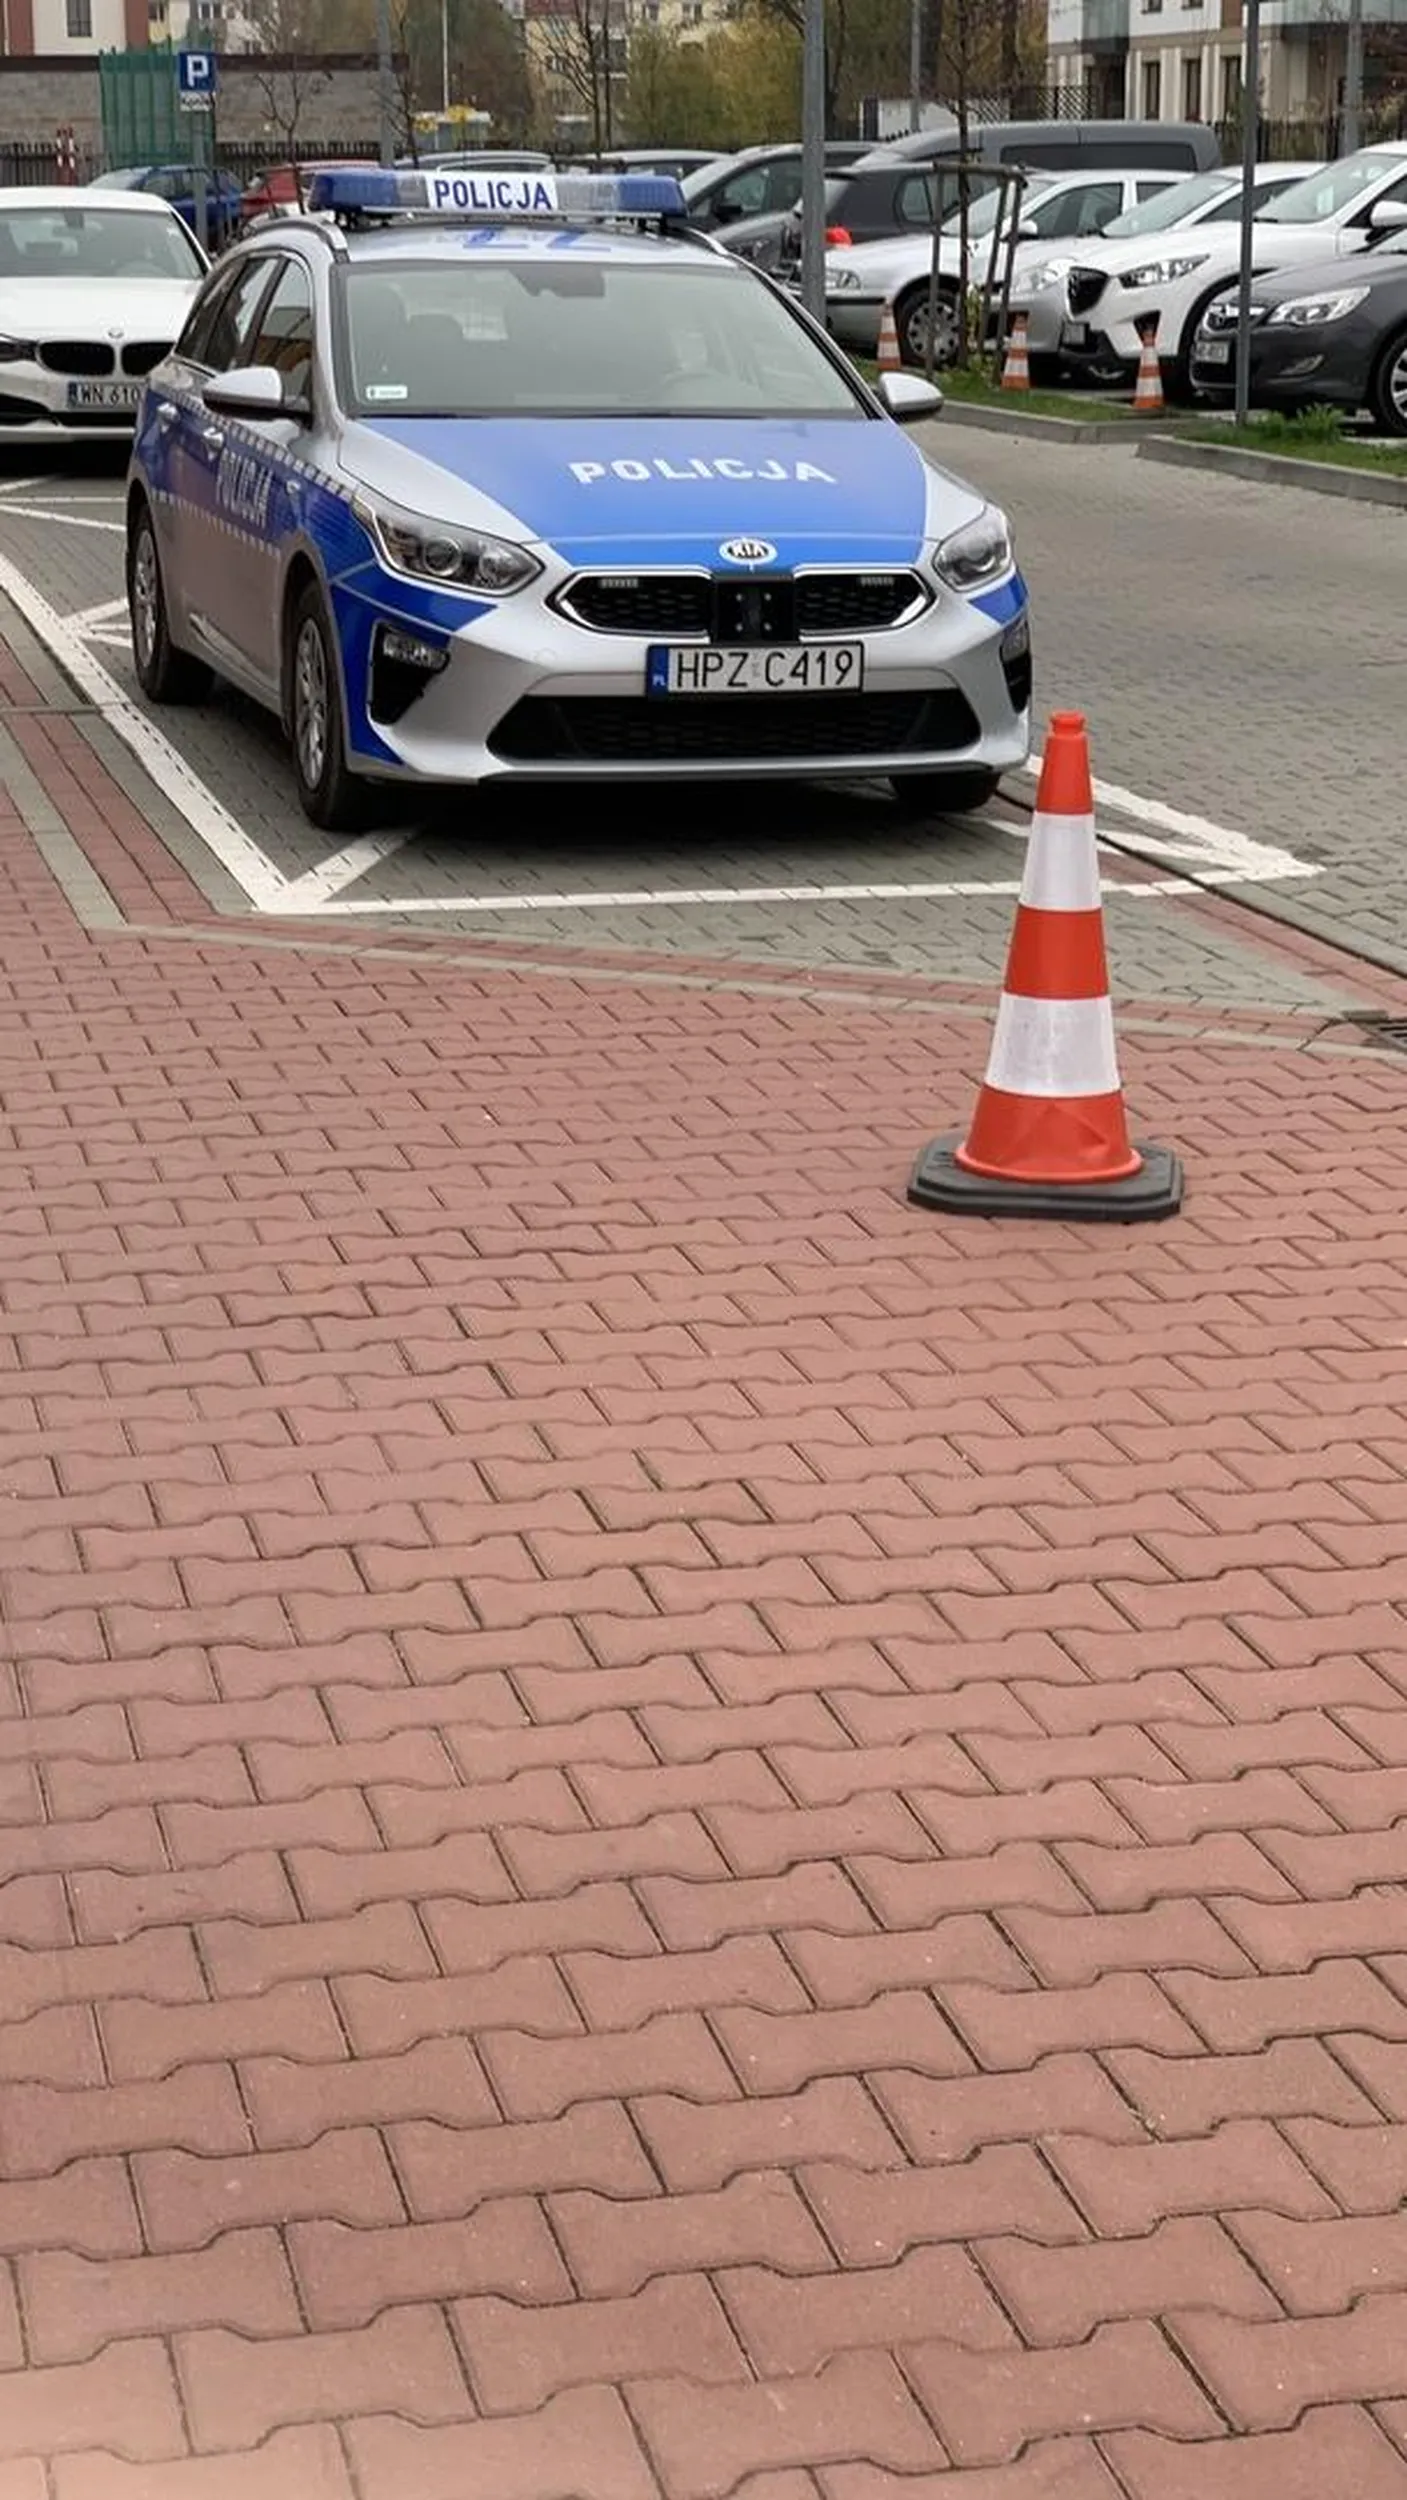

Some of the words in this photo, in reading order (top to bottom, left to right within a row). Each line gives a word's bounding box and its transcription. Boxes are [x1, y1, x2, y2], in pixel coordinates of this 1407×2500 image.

[187, 55, 209, 87] P
[434, 179, 553, 210] POLICJA
[80, 383, 104, 404] WN
[568, 458, 838, 485] POLICJA
[216, 447, 275, 529] POLICJA
[676, 651, 750, 688] HPZ
[764, 649, 854, 687] C419
